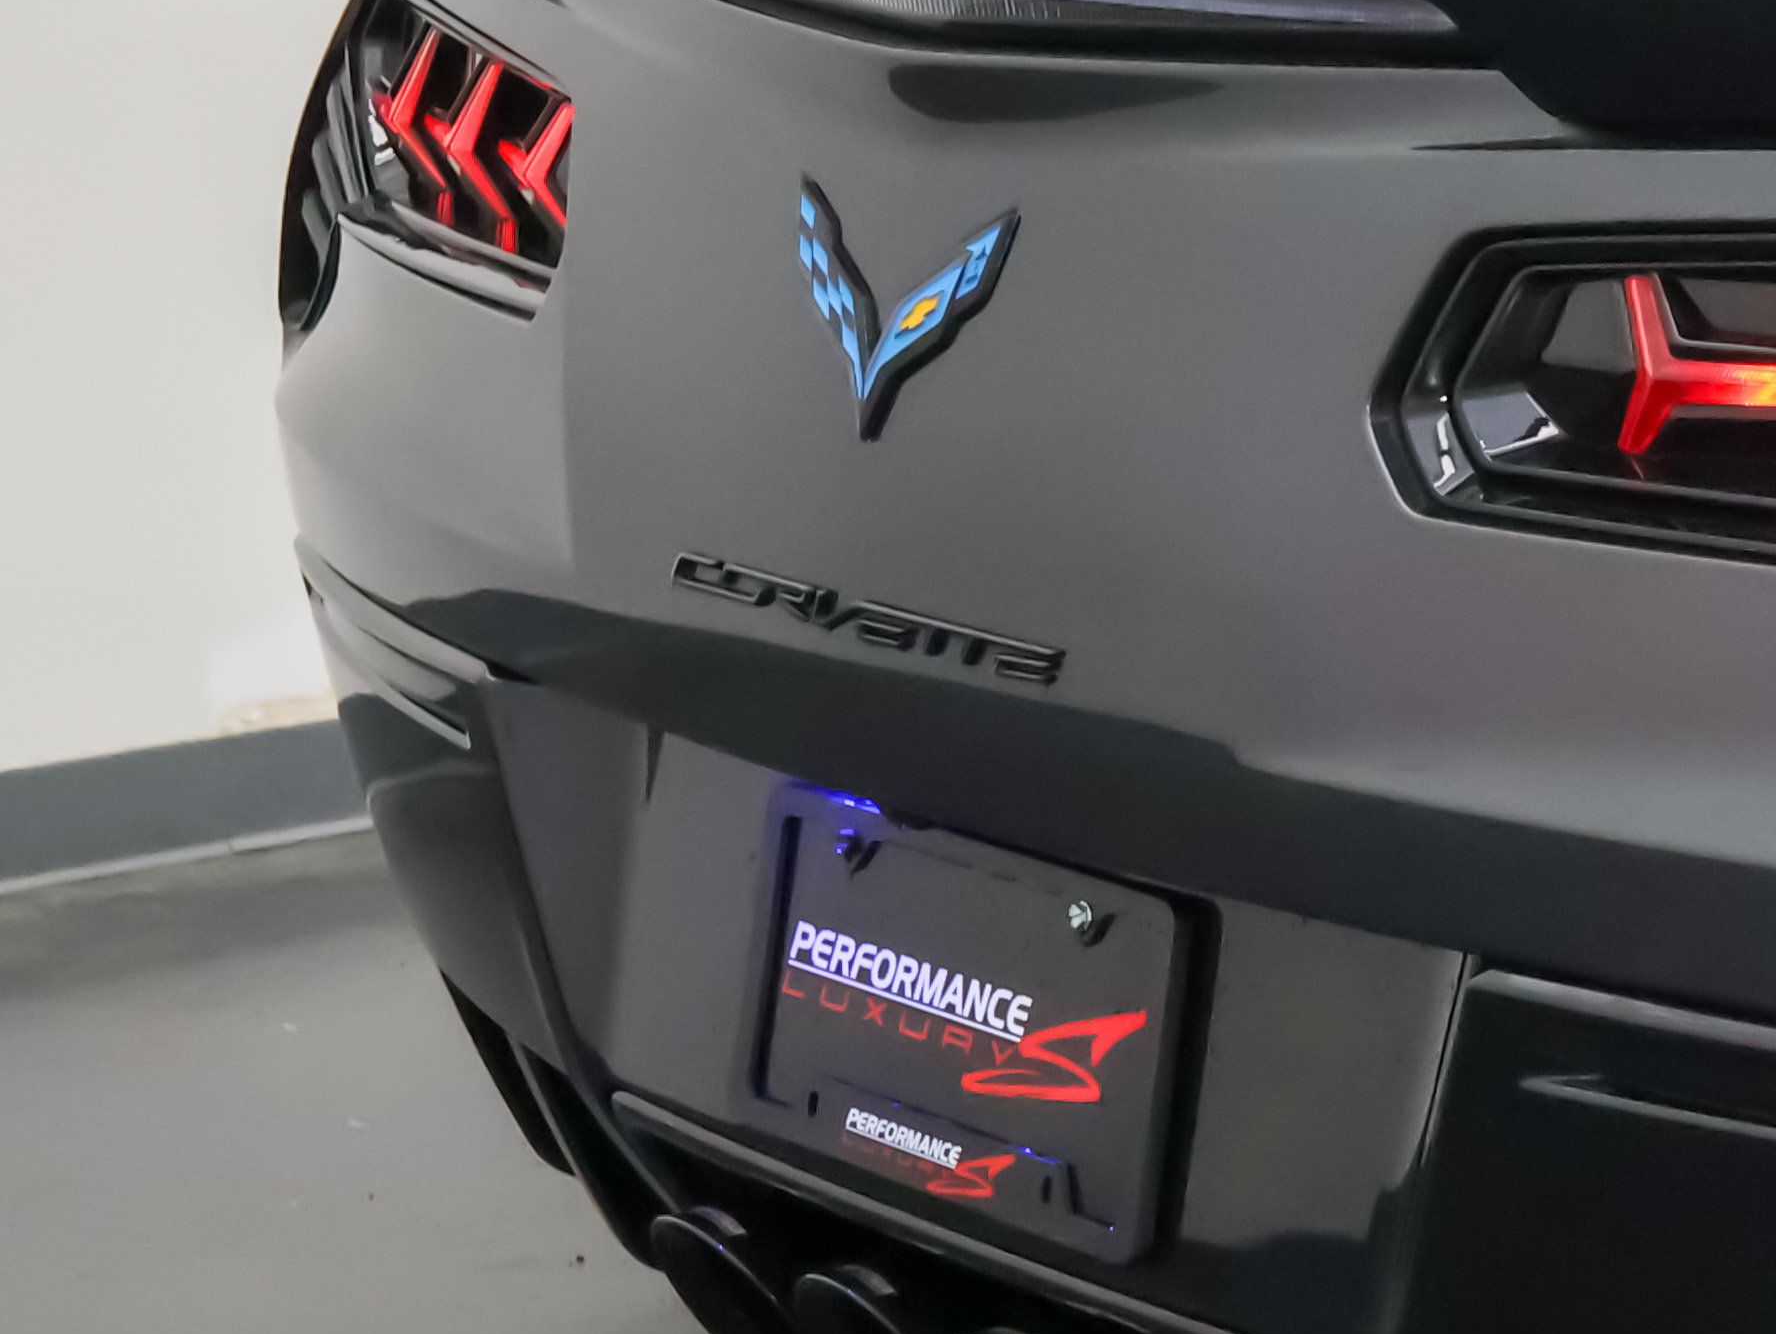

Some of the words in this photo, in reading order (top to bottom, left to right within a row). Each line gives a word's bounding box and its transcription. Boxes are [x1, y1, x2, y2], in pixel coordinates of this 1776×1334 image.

[781, 968, 1015, 1067] LUXURY
[788, 919, 1035, 1037] PERFORMANCE
[846, 1107, 963, 1167] PERFORMANCE
